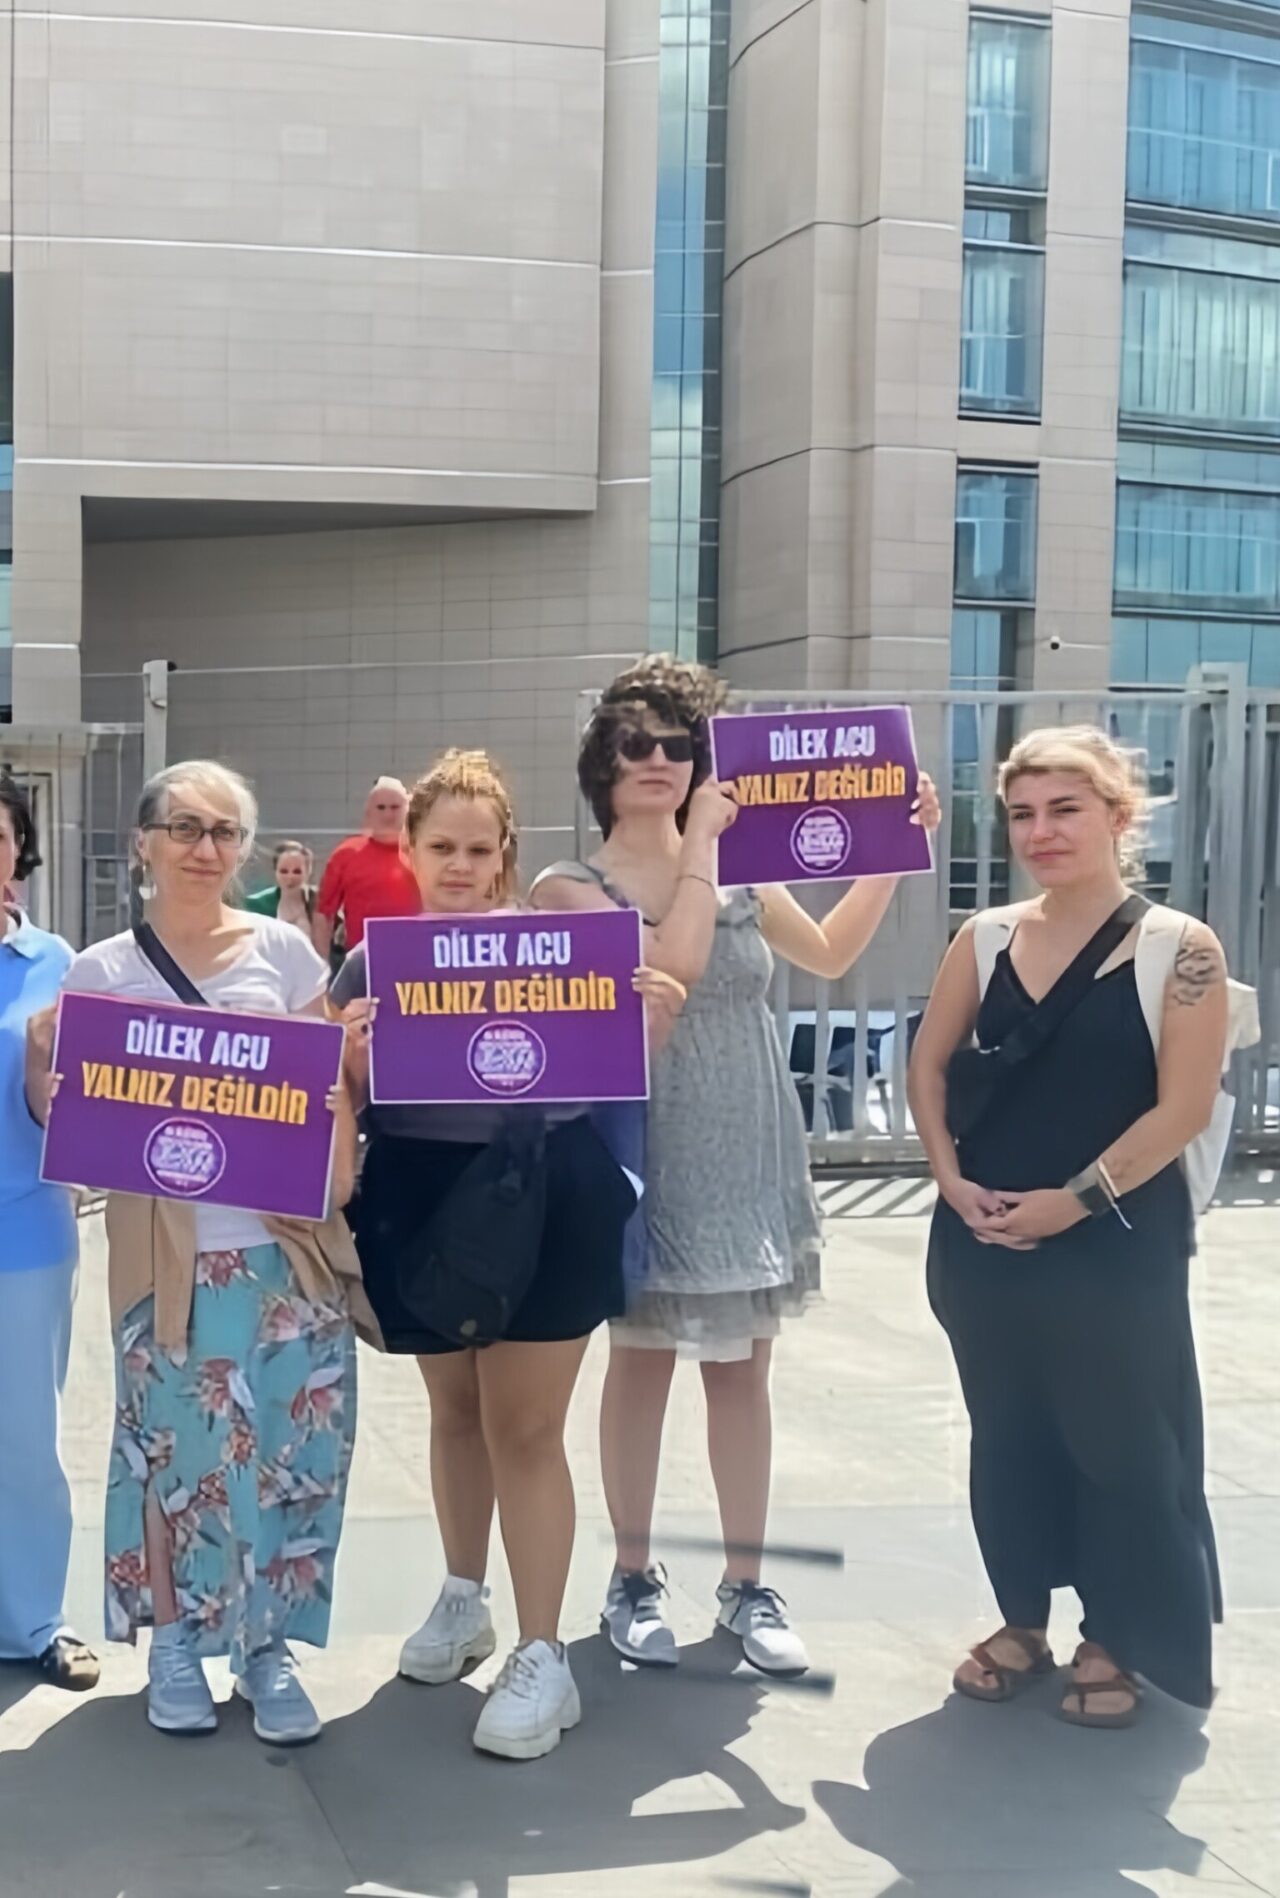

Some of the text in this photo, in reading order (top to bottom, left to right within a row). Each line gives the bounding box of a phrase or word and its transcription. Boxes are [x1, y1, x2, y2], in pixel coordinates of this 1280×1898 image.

[769, 723, 828, 761] DİLEK
[433, 927, 571, 968] DİLEK ACU
[395, 970, 616, 1015] YALNIZ DEĞİLDİR
[126, 1014, 270, 1070] DİLEK ACU
[81, 1061, 308, 1125] YALNIZ DEĞİLDİR
